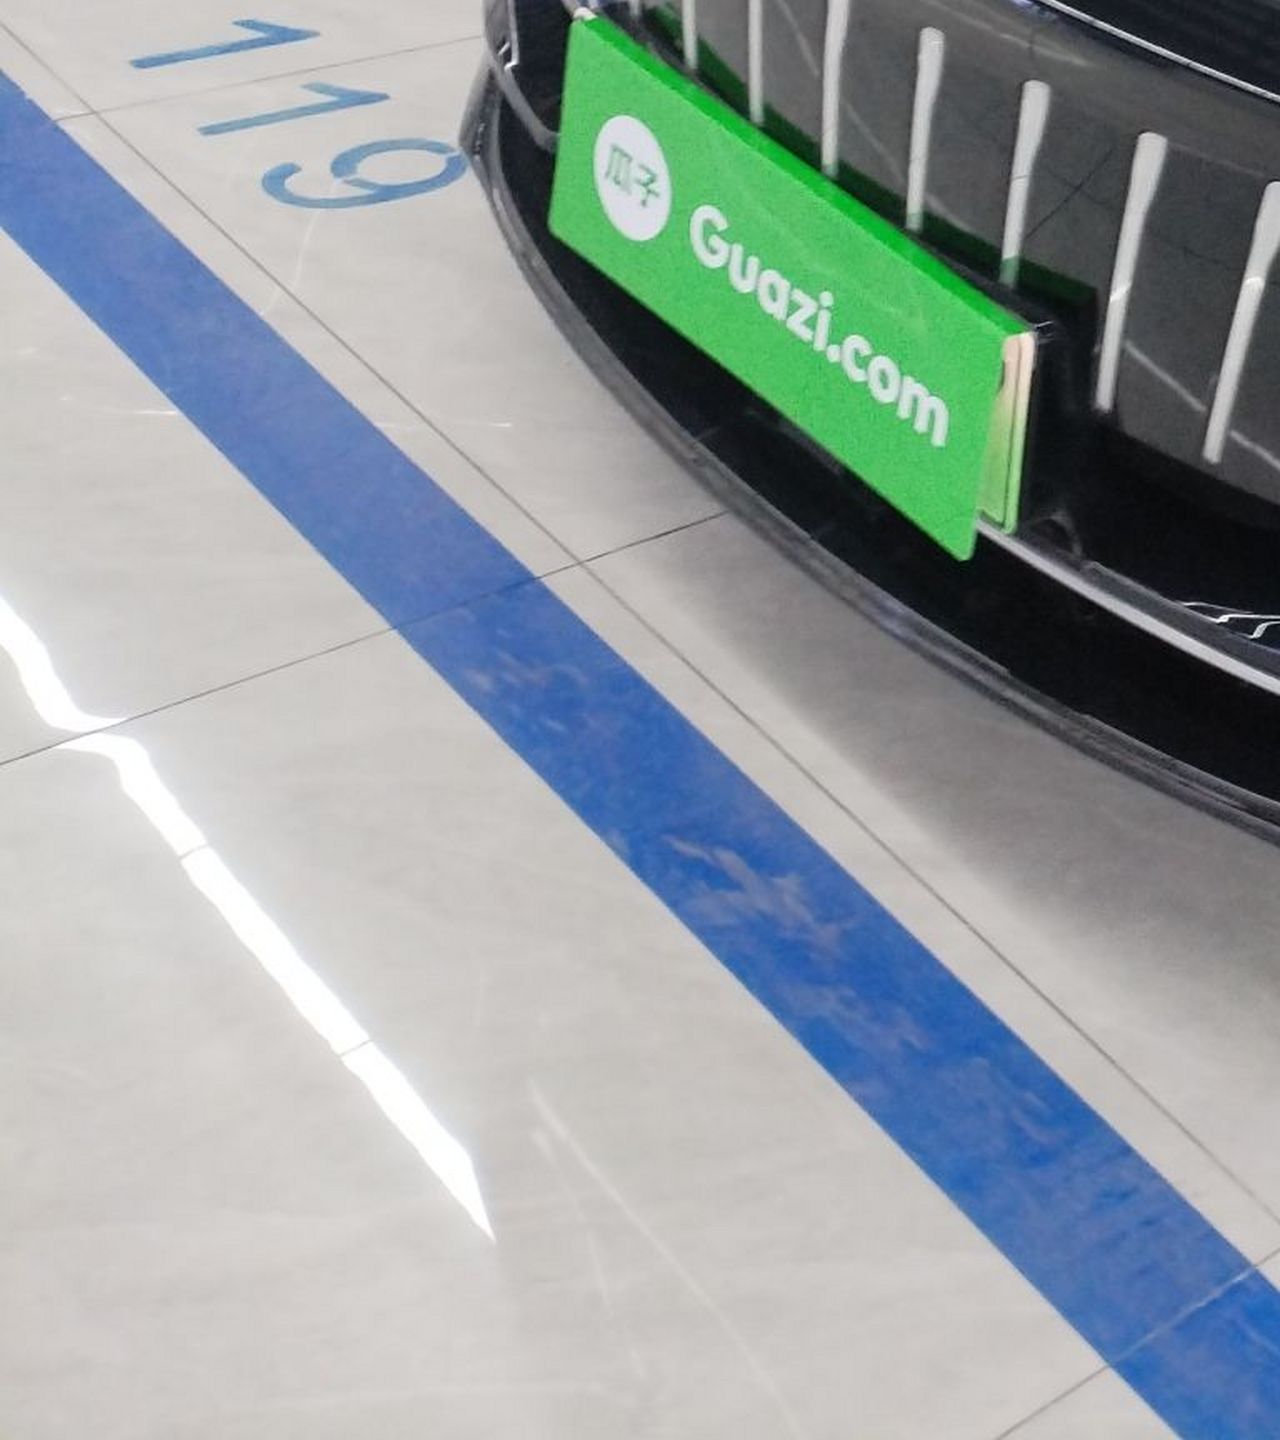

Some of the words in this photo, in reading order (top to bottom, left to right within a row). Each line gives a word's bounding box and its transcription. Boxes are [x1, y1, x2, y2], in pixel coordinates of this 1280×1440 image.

[130, 18, 469, 210] 119
[604, 142, 661, 209] 瓜子
[688, 203, 951, 448] Guazi.com
